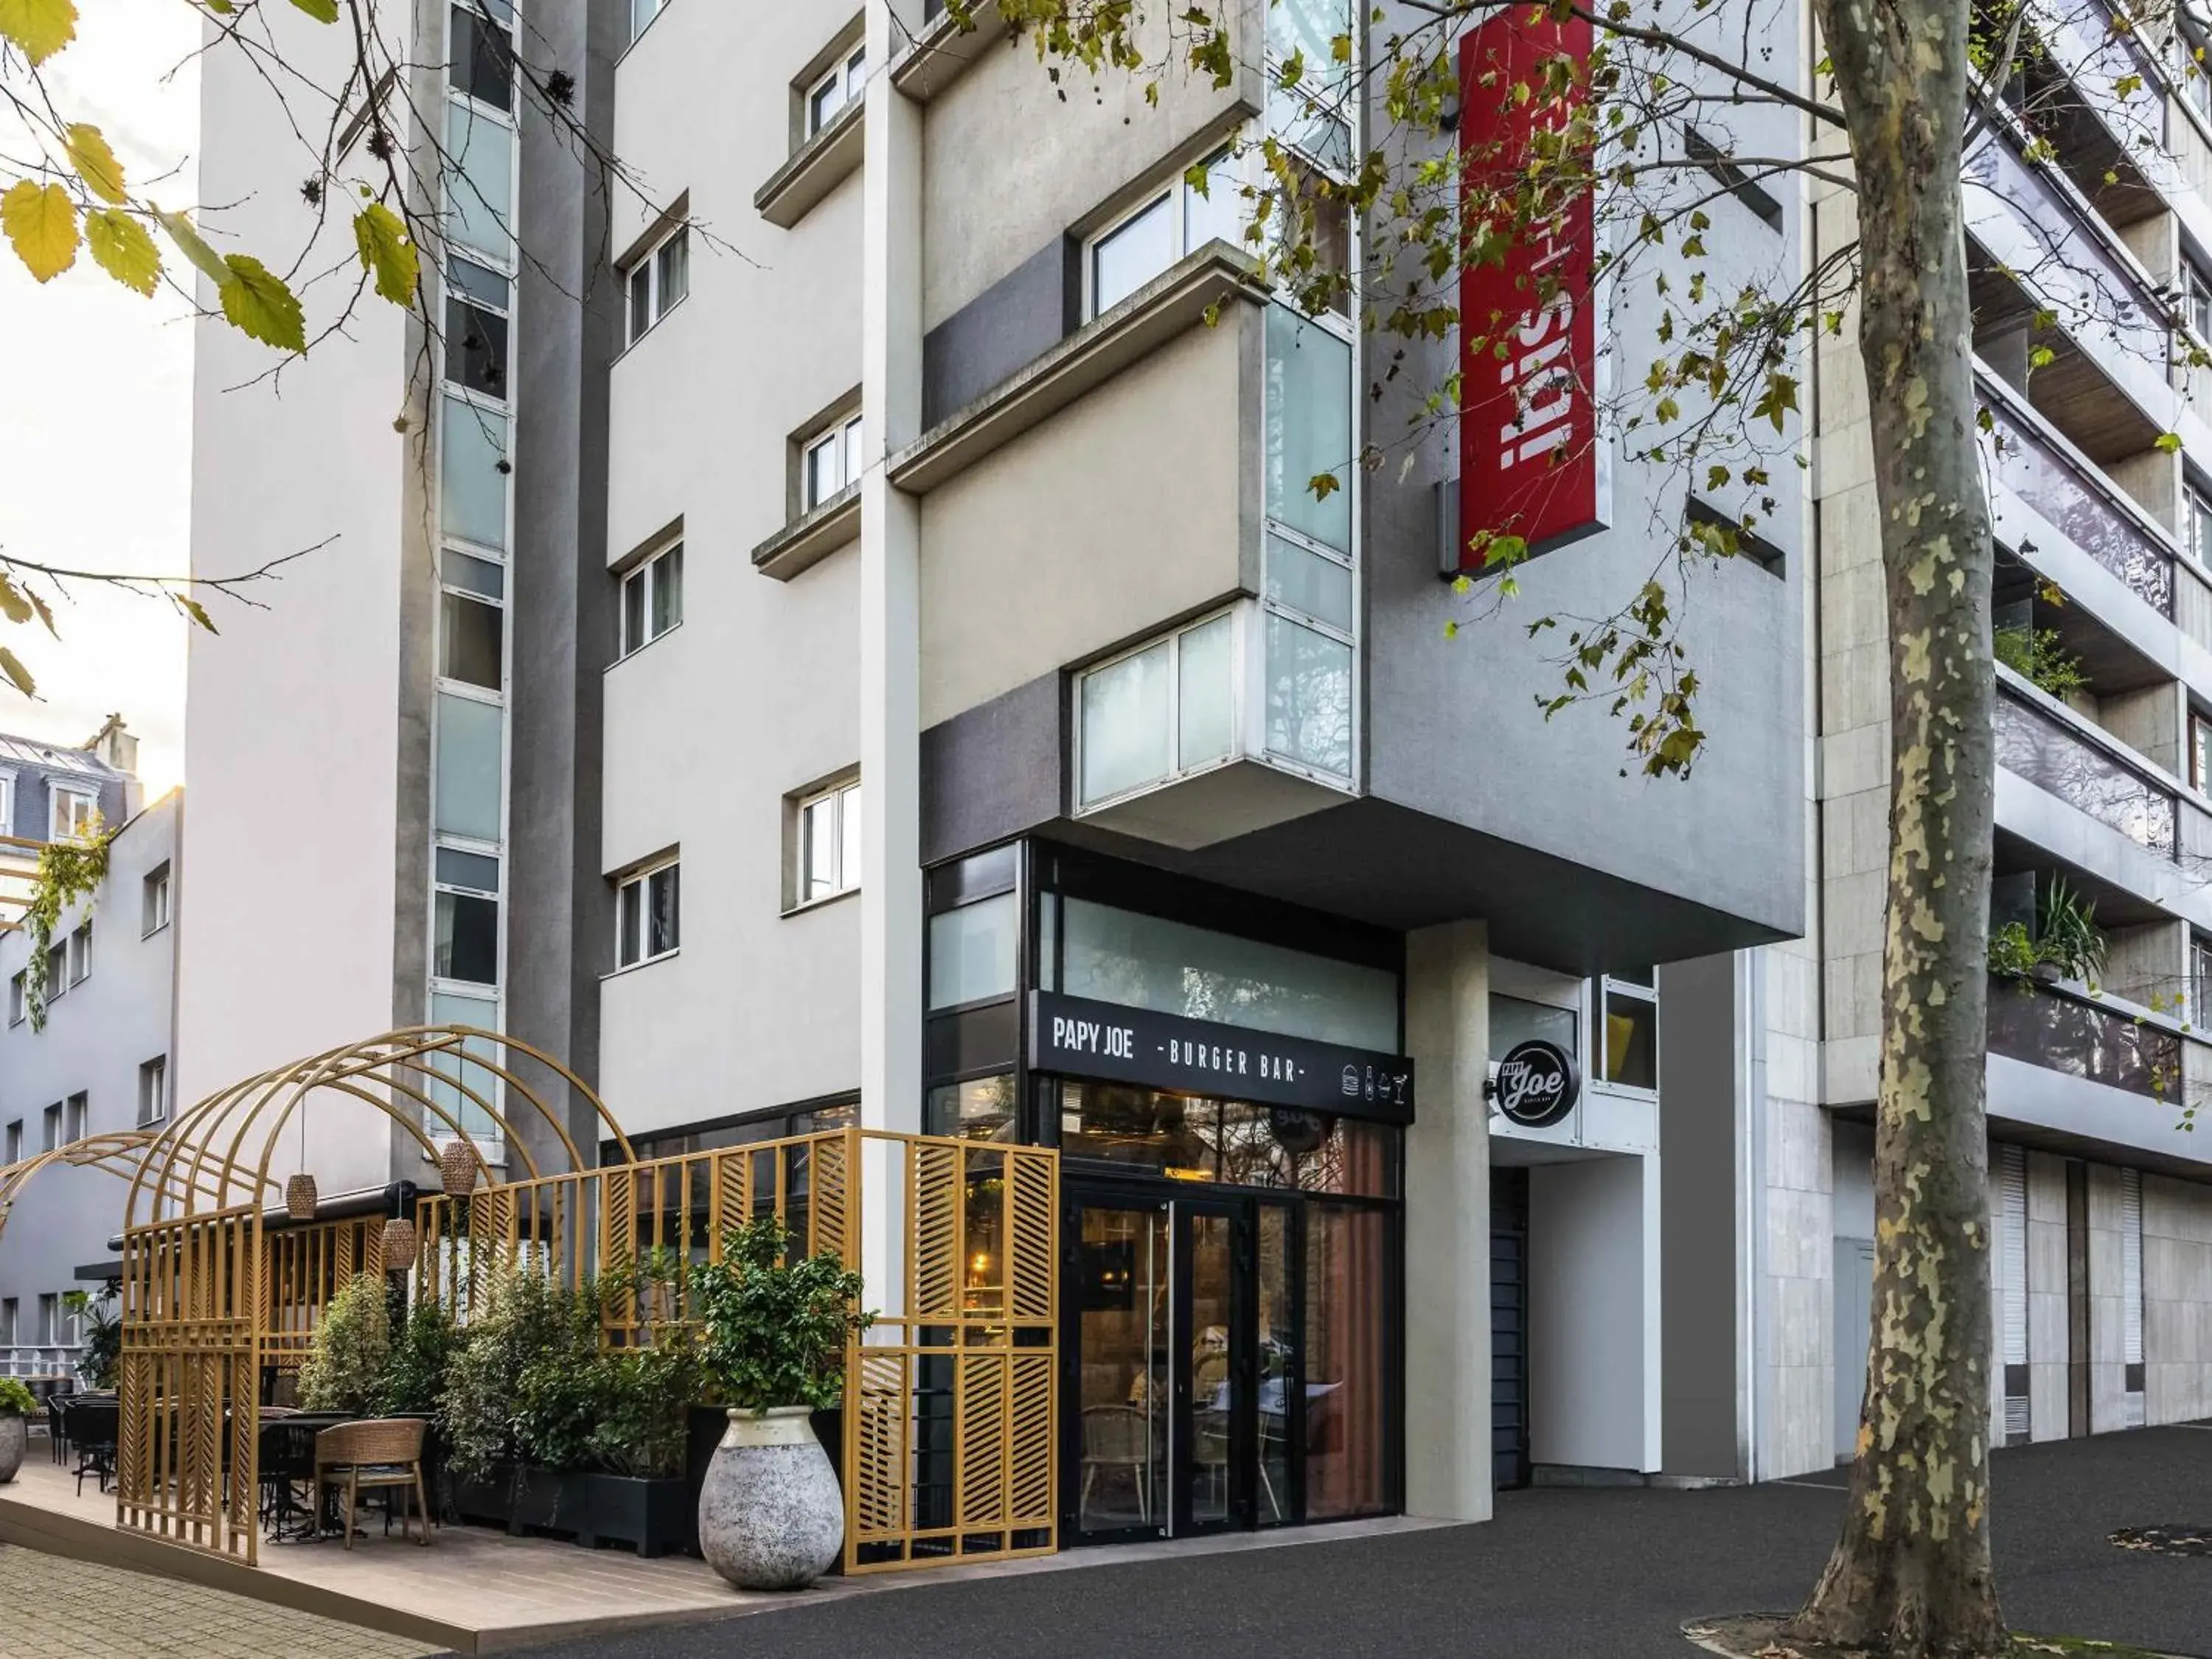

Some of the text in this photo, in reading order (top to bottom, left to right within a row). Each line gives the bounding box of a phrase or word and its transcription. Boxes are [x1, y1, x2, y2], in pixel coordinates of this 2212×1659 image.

[1500, 290, 1573, 470] ibis
[1054, 1017, 1100, 1053] PAPY
[1104, 1026, 1133, 1059] JOE
[1504, 1064, 1565, 1110] Joe
